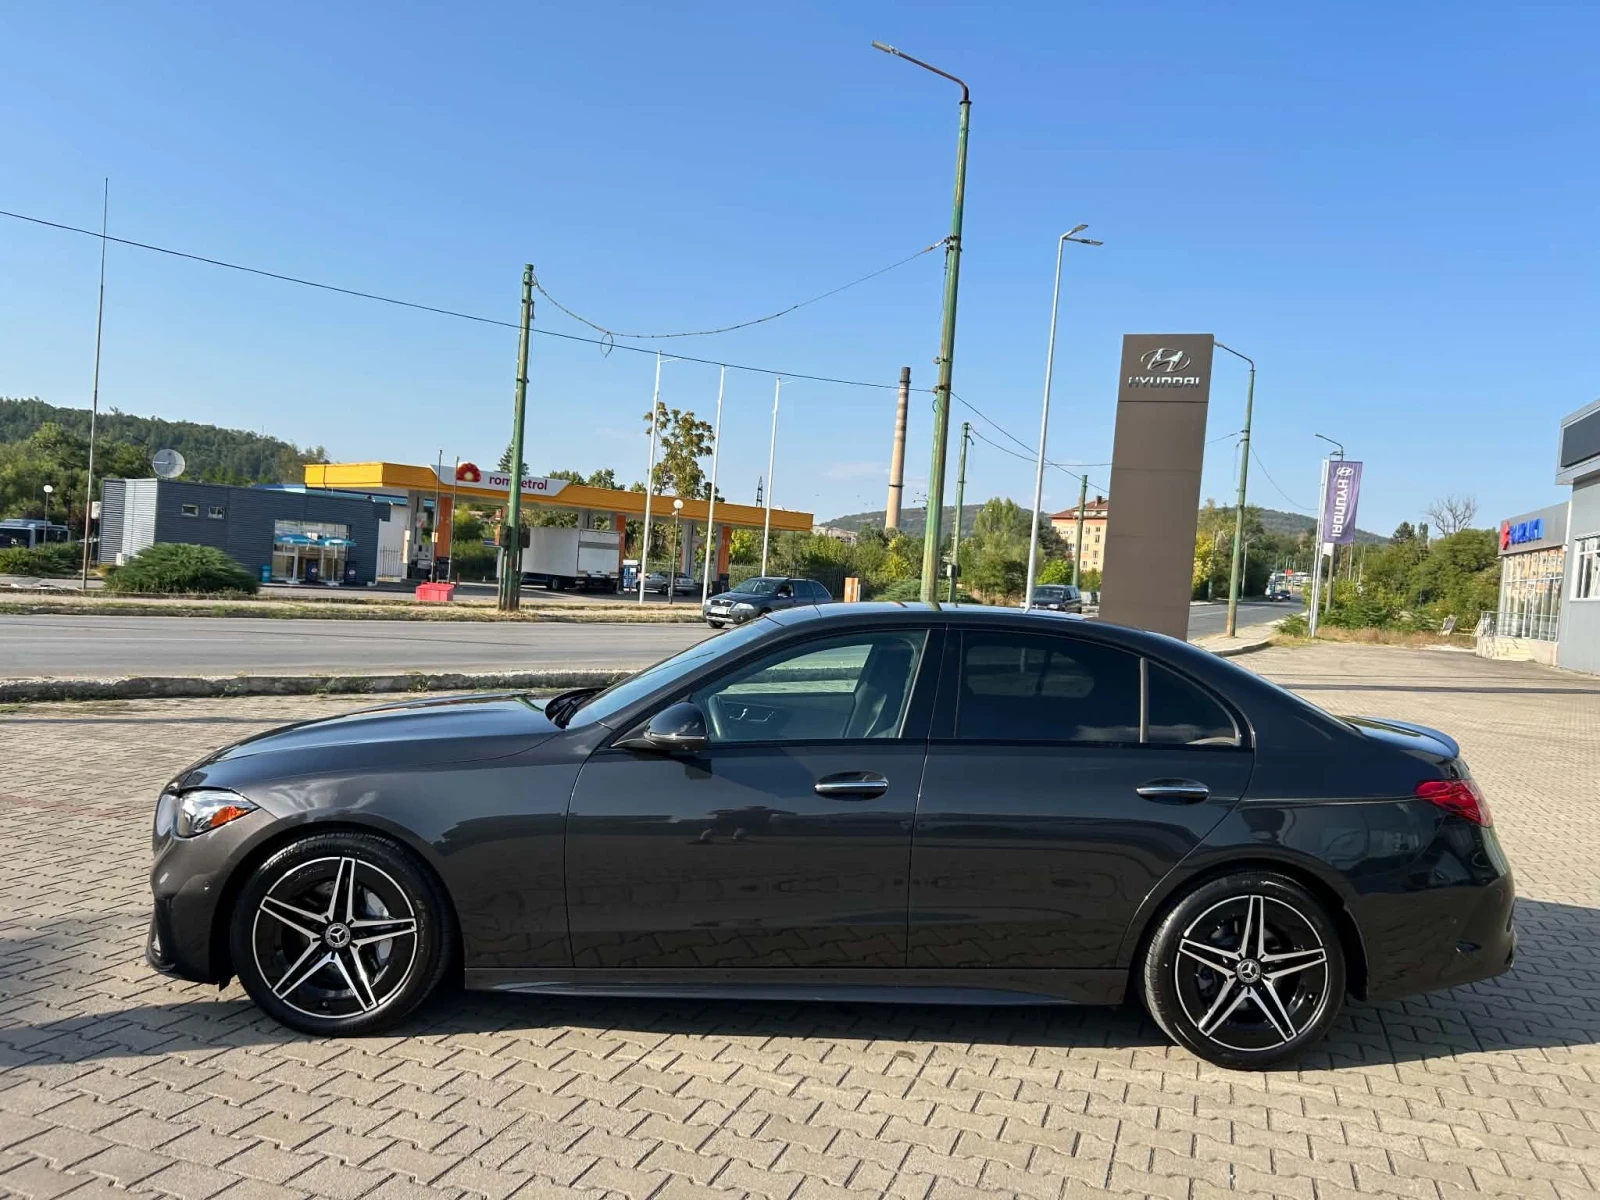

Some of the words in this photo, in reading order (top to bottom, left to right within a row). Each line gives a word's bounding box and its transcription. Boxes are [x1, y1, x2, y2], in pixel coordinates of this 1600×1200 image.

[1128, 376, 1200, 386] HYUNDAI
[488, 475, 548, 490] rometrol
[1331, 479, 1349, 537] HYUNDAI
